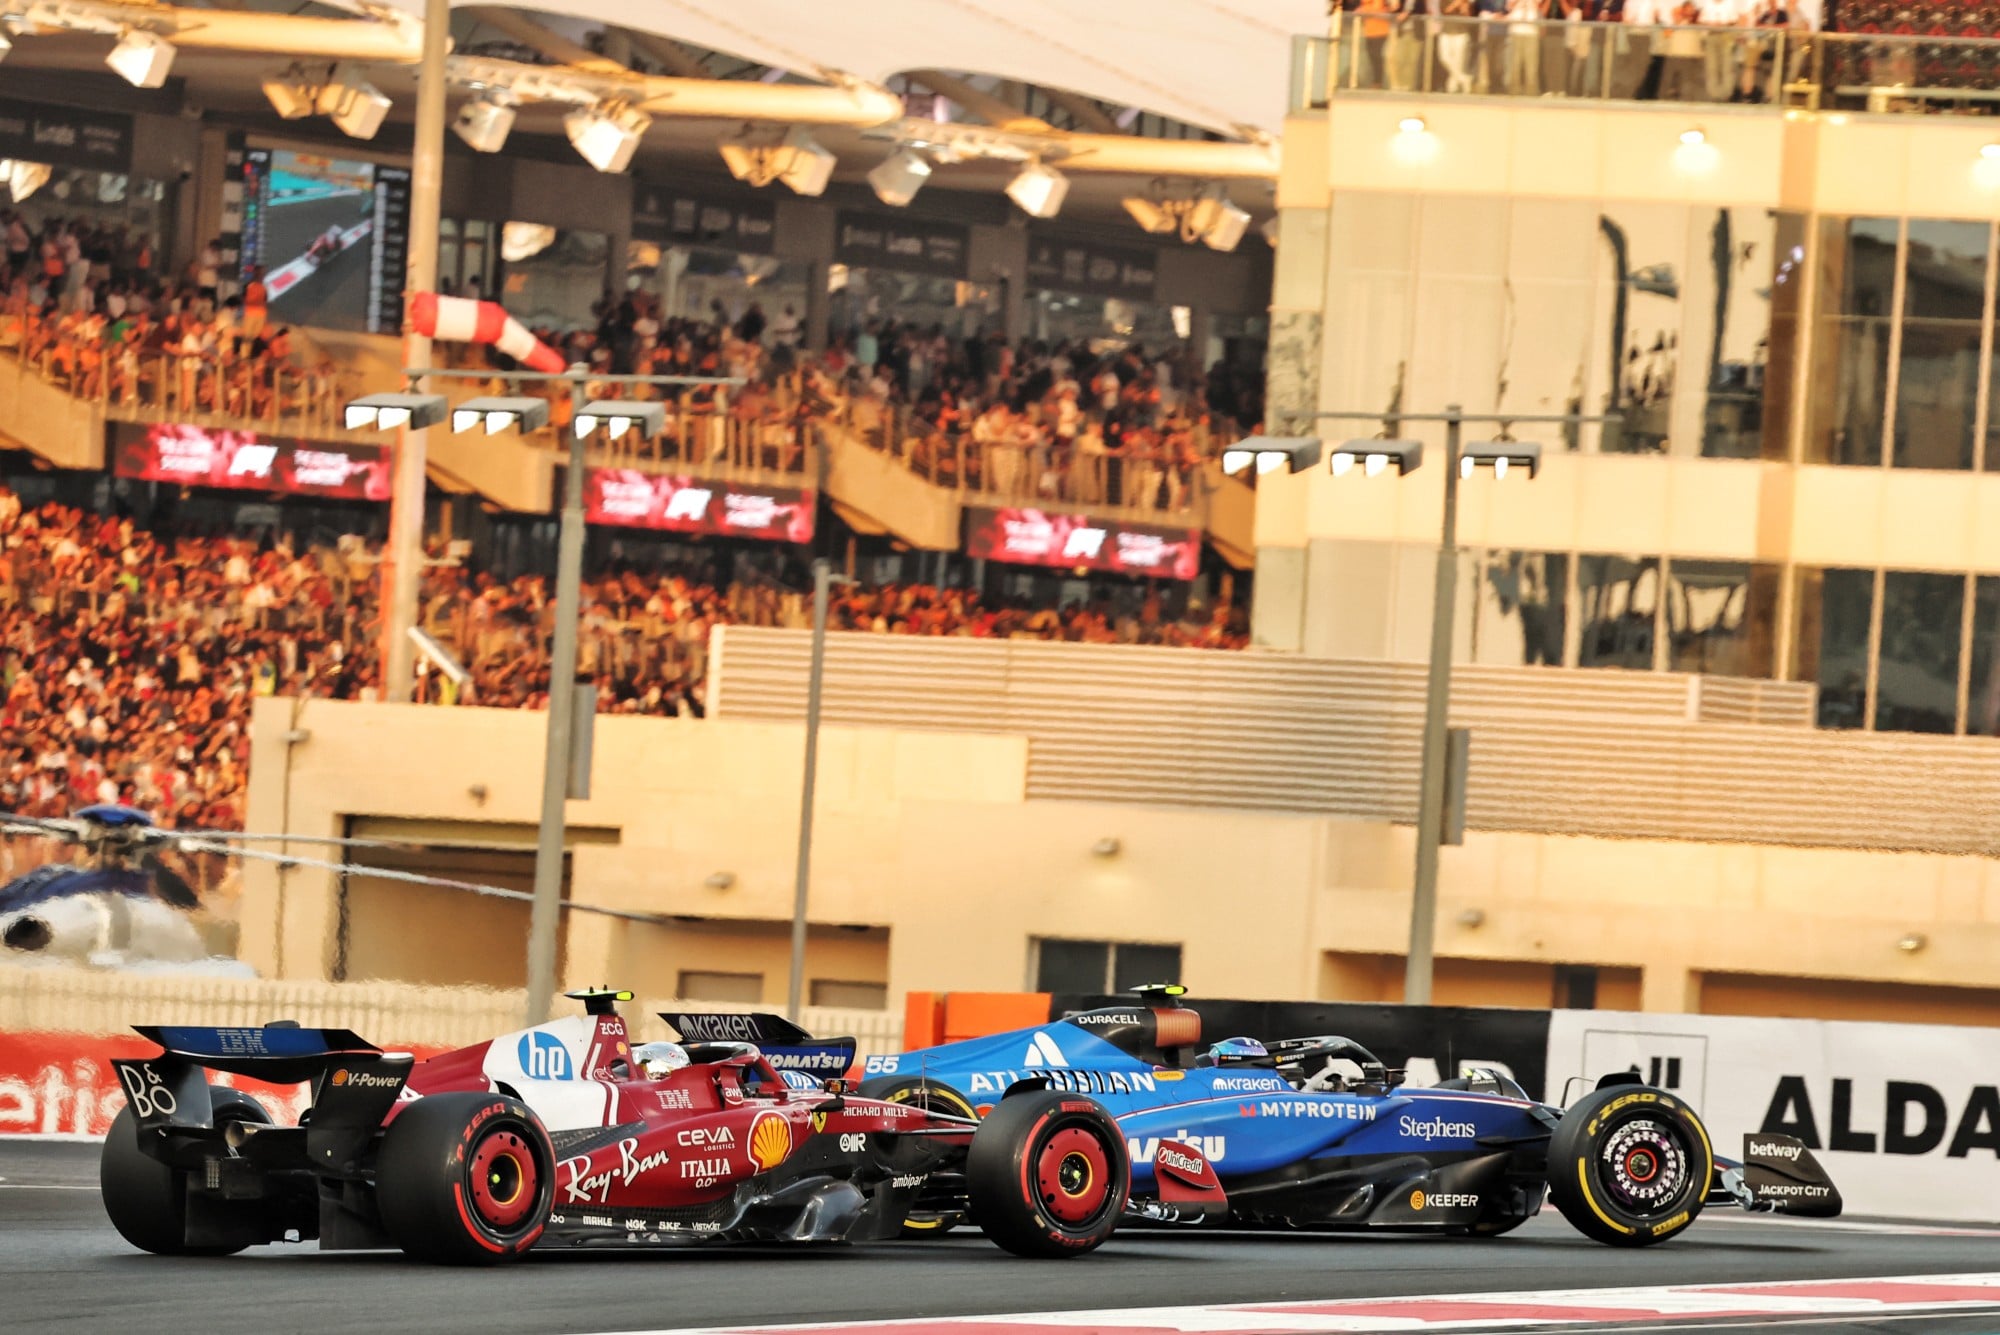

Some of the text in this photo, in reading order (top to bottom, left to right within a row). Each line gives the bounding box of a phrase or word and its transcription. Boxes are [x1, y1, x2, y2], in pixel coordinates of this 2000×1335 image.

[692, 1014, 763, 1041] kraken
[1078, 1014, 1140, 1025] DURACELL
[216, 1029, 268, 1054] IBM
[528, 1031, 565, 1080] hp
[866, 1056, 899, 1074] 55
[348, 1073, 401, 1087] V-Power
[970, 1070, 1156, 1094] ATSSIAN
[1227, 1078, 1281, 1091] kraken
[656, 1090, 693, 1109] IBM
[1600, 1093, 1657, 1120] ZERO
[844, 1107, 908, 1118] RICHARD MILLE
[1261, 1102, 1376, 1121] MYPROTEIN
[463, 1103, 506, 1141] ZERO
[1400, 1115, 1475, 1141] Stephens
[1749, 1141, 1802, 1161] betway
[681, 1158, 731, 1178] ITALIA
[1166, 1150, 1203, 1174] UniCredit
[892, 1174, 923, 1189] ambipar
[1758, 1184, 1829, 1196] JACKPOT CITY
[1425, 1194, 1479, 1207] KEEPER
[583, 1215, 613, 1227] MAHLE
[626, 1219, 647, 1231] NGK
